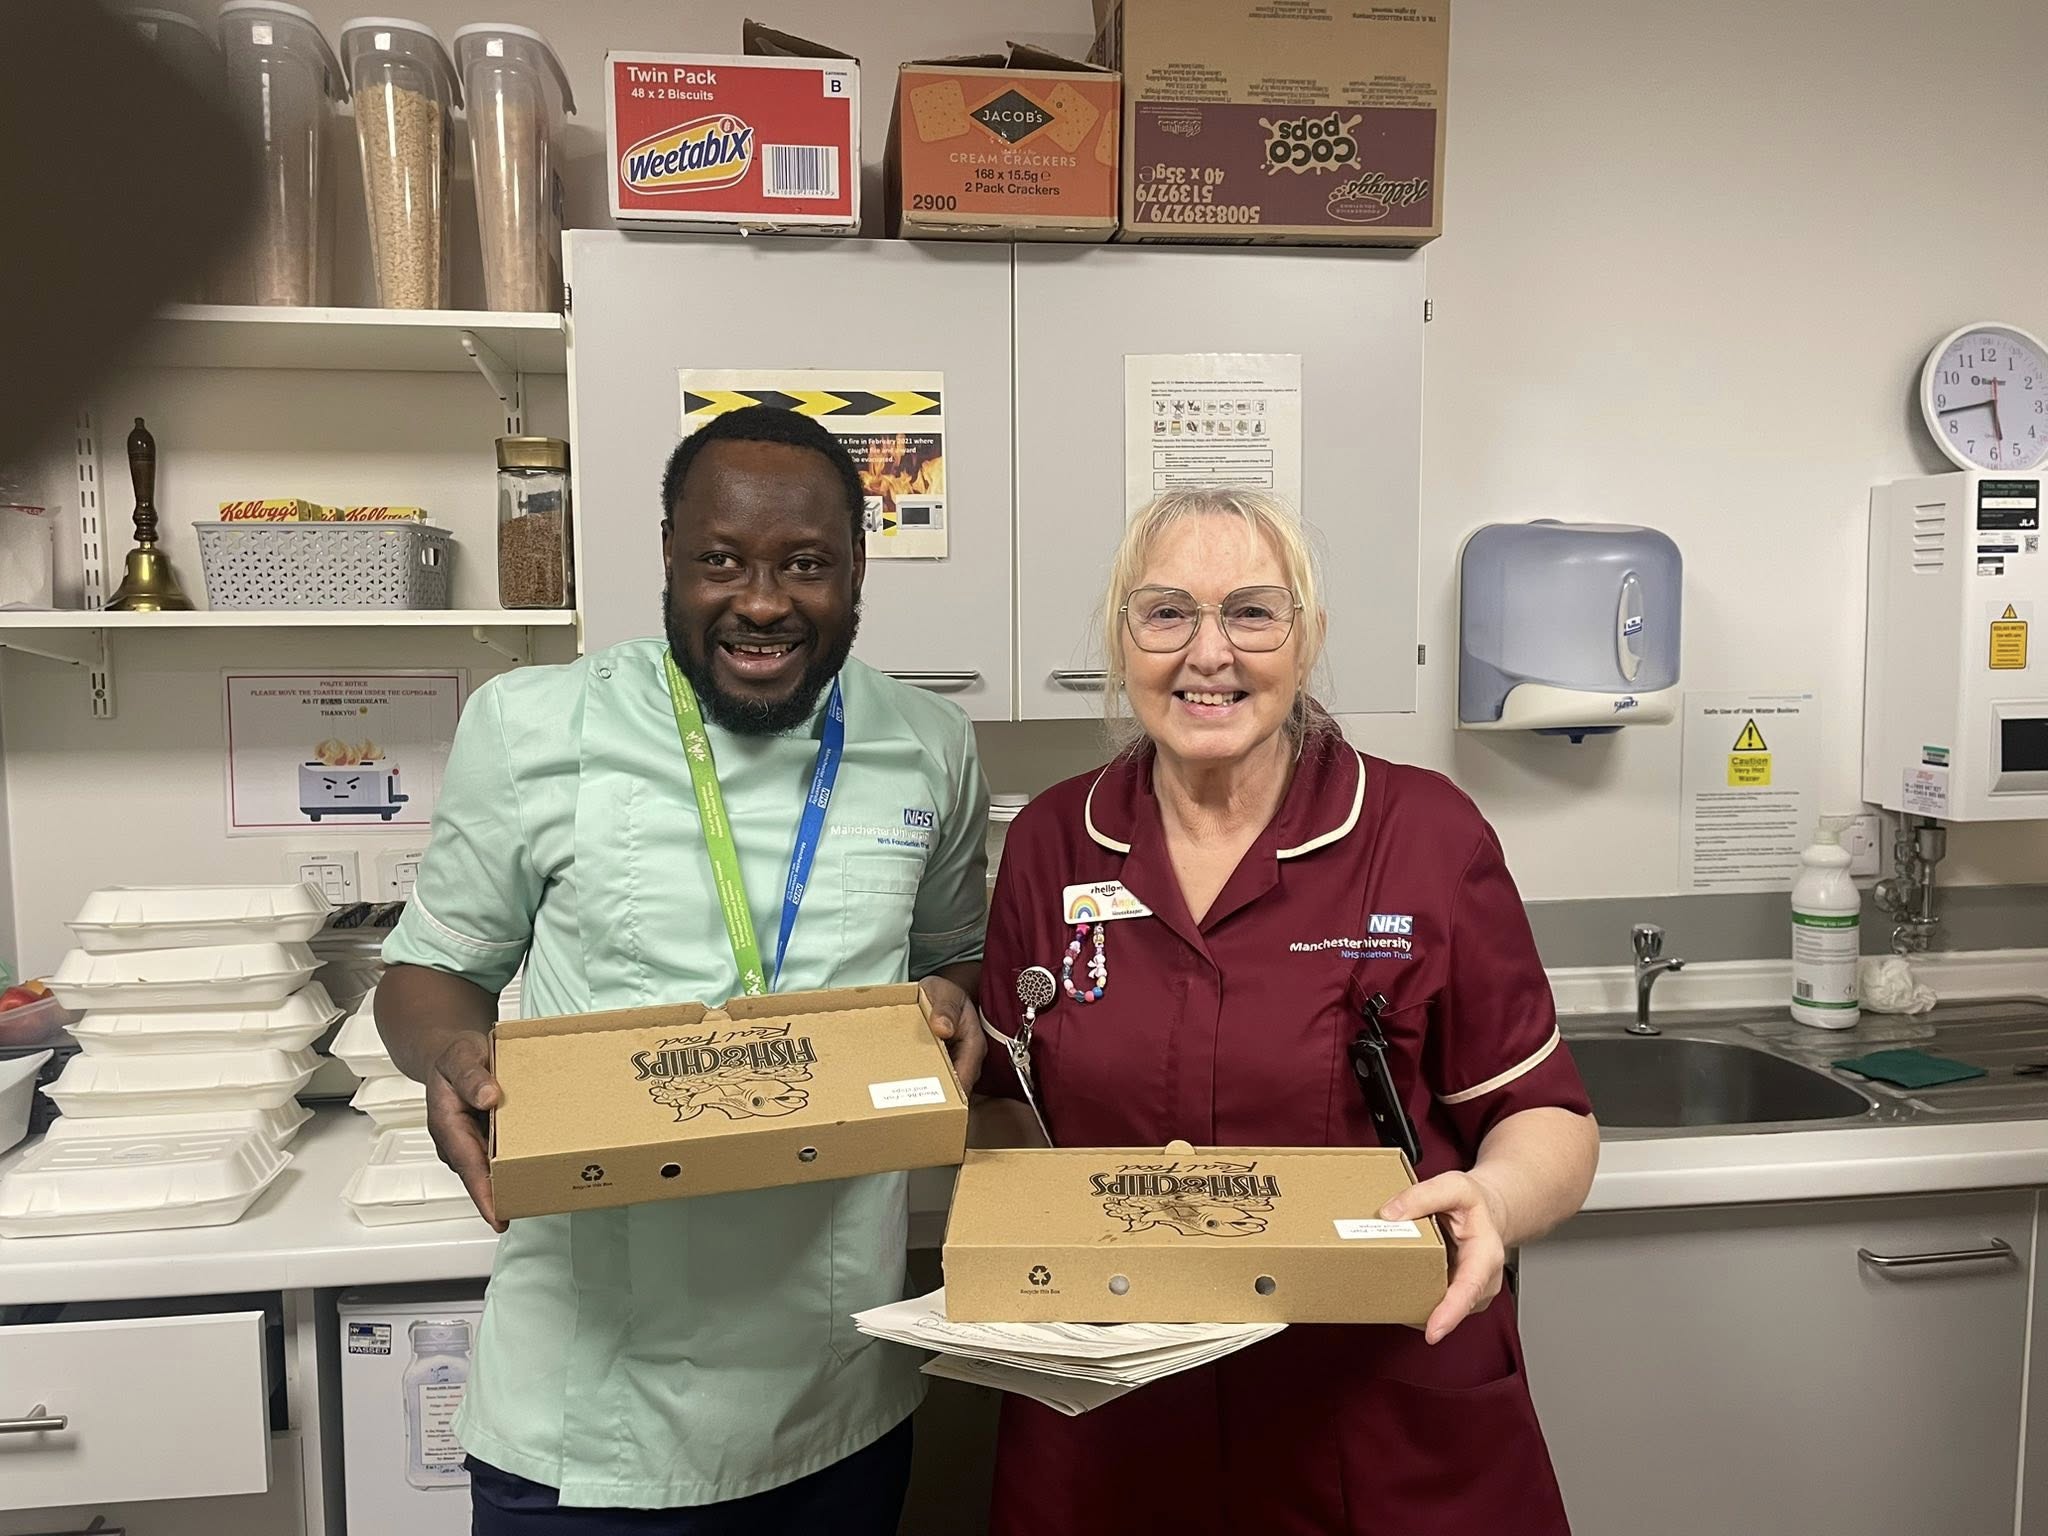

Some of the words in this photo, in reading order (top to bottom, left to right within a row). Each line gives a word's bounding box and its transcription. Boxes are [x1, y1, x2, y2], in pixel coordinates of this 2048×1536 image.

[627, 66, 668, 83] Twin
[674, 68, 717, 85] Pack
[831, 80, 841, 93] B
[631, 88, 645, 99] 48
[648, 90, 655, 98] x
[658, 89, 665, 99] 2
[668, 89, 714, 101] Biscuits
[629, 118, 753, 184] Weetabix
[950, 152, 998, 165] CREAM
[1004, 154, 1077, 167] CRACKERS
[975, 169, 994, 180] 168
[997, 171, 1004, 180] x
[1190, 168, 1200, 180] x
[1204, 168, 1225, 185] 40
[965, 182, 972, 192] 2
[975, 182, 1004, 193] Pack
[1007, 184, 1060, 195] Crackers
[1135, 183, 1214, 203] 5139279
[1346, 172, 1429, 208] Kellogg's
[913, 194, 957, 211] 2900
[1150, 204, 1261, 224] 5008339279
[1959, 354, 1974, 369] 11
[1980, 348, 1996, 362] 12
[2009, 357, 2014, 371] 1
[1943, 371, 1960, 385] 10
[2024, 376, 2032, 390] 2
[1937, 394, 1946, 408] 9
[2034, 400, 2043, 414] 3
[1950, 420, 1958, 434] 8
[2028, 425, 2036, 439] 4
[913, 437, 934, 445] where
[1967, 440, 1975, 454] 7
[847, 447, 869, 455] caught
[1990, 447, 1998, 461] 6
[2012, 443, 2021, 457] 5
[2019, 519, 2035, 527] JLA
[1731, 757, 1768, 765] Caution
[819, 789, 829, 807] NHS
[905, 810, 933, 827] NHS
[830, 825, 890, 836] Manchester
[877, 837, 891, 845] NHS
[793, 884, 802, 904] NHS
[1369, 915, 1413, 933] NHS
[1290, 937, 1362, 952] Manchester
[1341, 951, 1360, 959] NHS
[350, 1346, 389, 1354] PASSED
